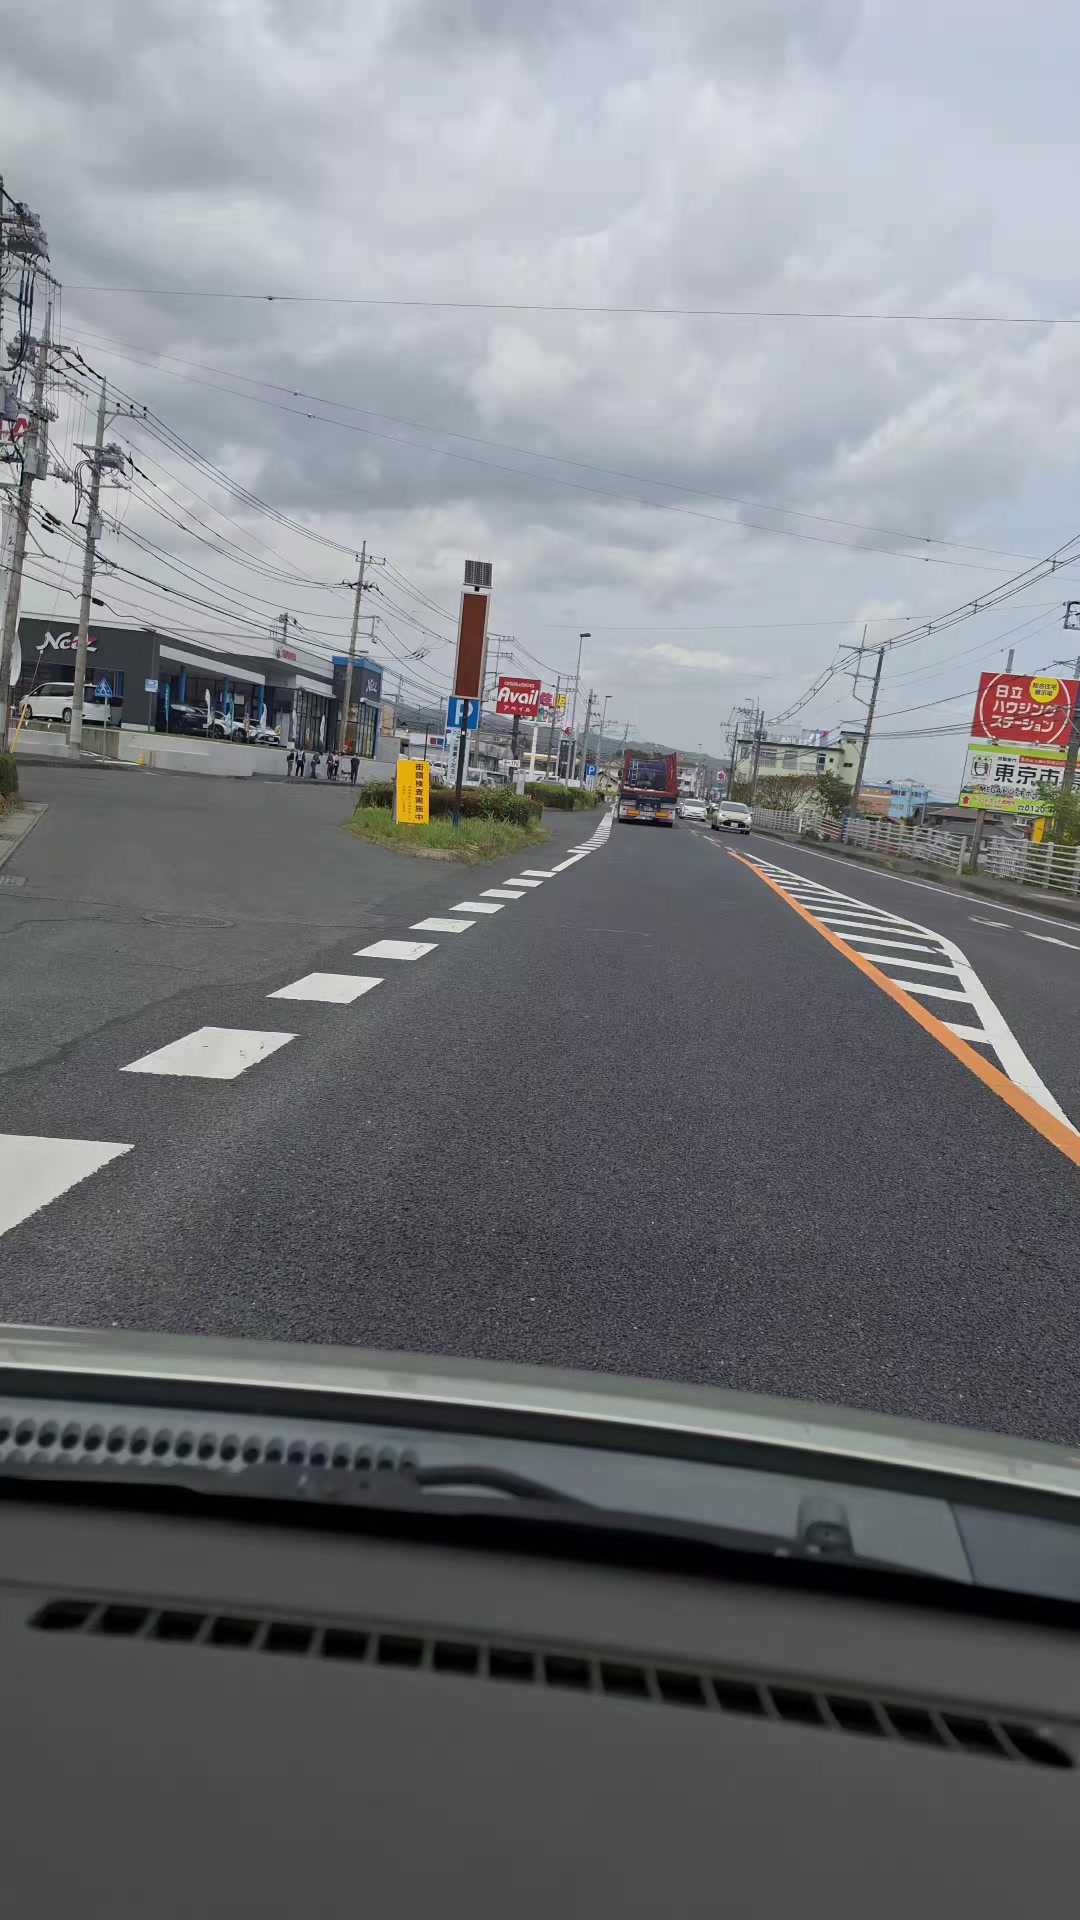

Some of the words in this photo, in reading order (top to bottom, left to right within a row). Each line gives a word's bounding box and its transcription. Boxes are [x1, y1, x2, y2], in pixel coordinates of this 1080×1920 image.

[497, 686, 539, 706] Avail
[995, 684, 1023, 699] 日立
[993, 700, 1057, 718] ハウジング
[990, 715, 1055, 733] ステーション
[588, 766, 596, 776] P
